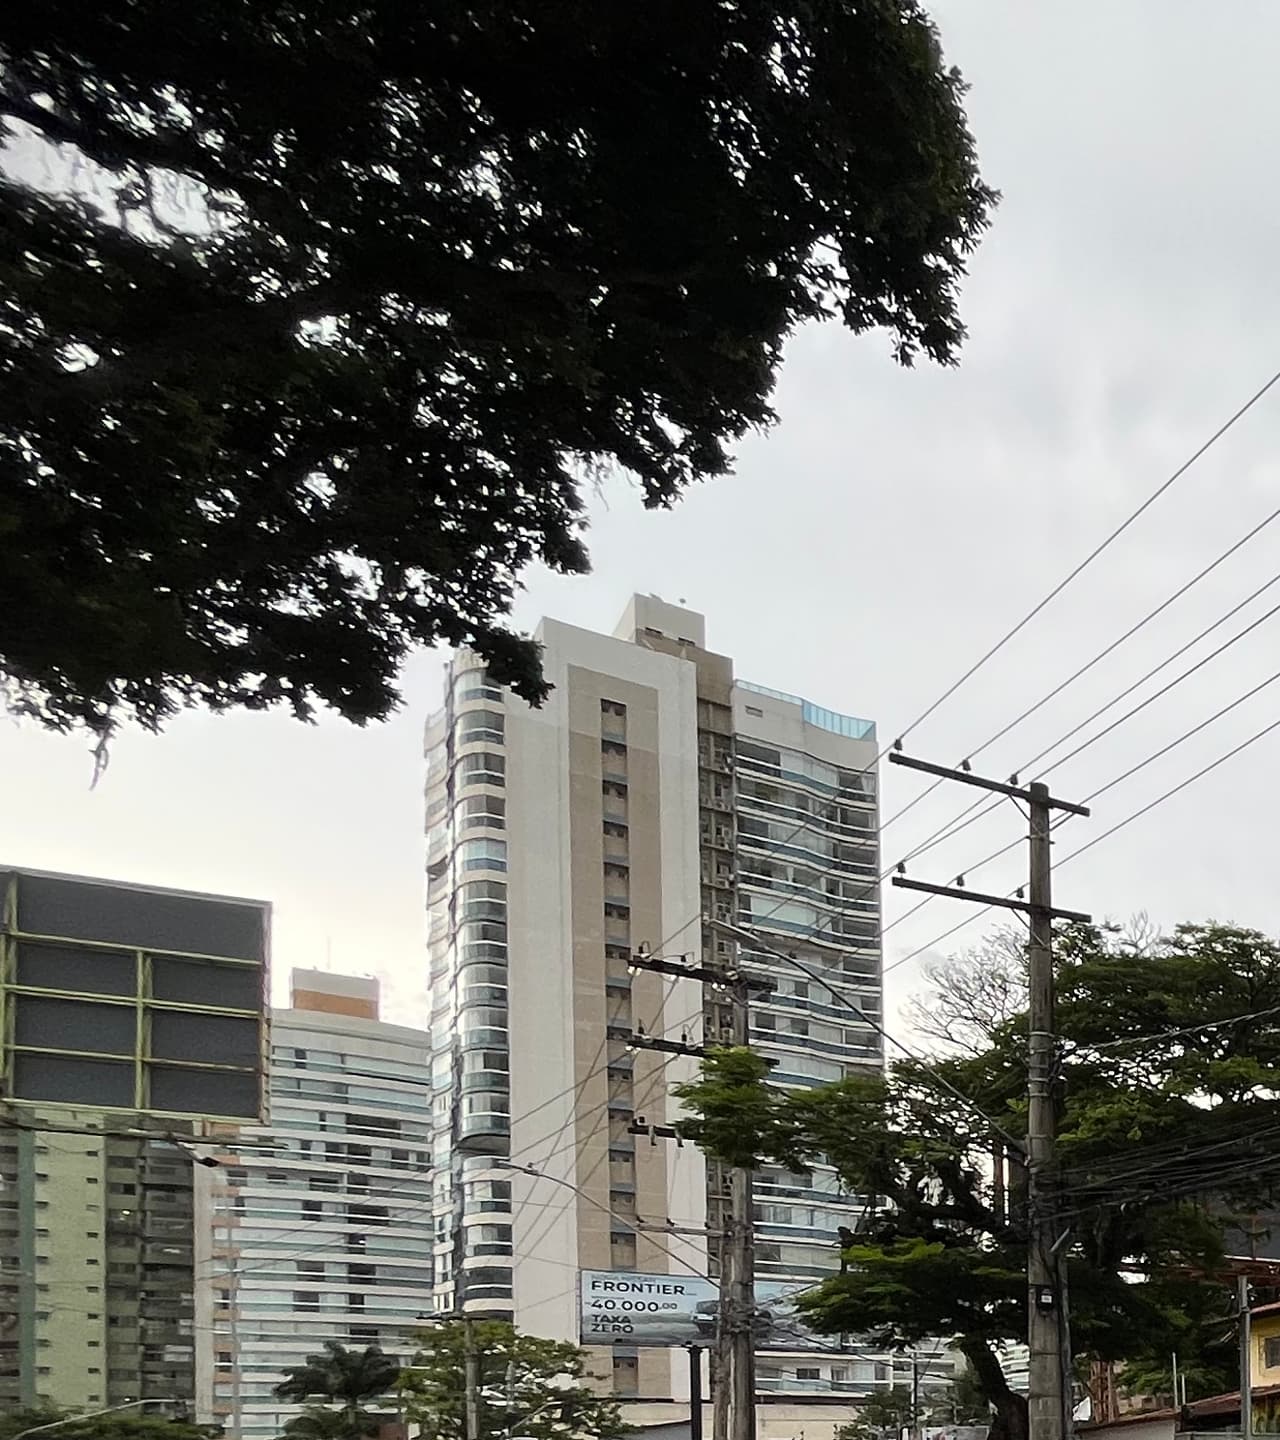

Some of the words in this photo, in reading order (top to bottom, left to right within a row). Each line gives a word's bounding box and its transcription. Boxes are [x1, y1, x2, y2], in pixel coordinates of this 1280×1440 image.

[591, 1280, 685, 1295] FRONTIER
[591, 1314, 632, 1324] TAXA
[591, 1323, 634, 1334] ZERO
